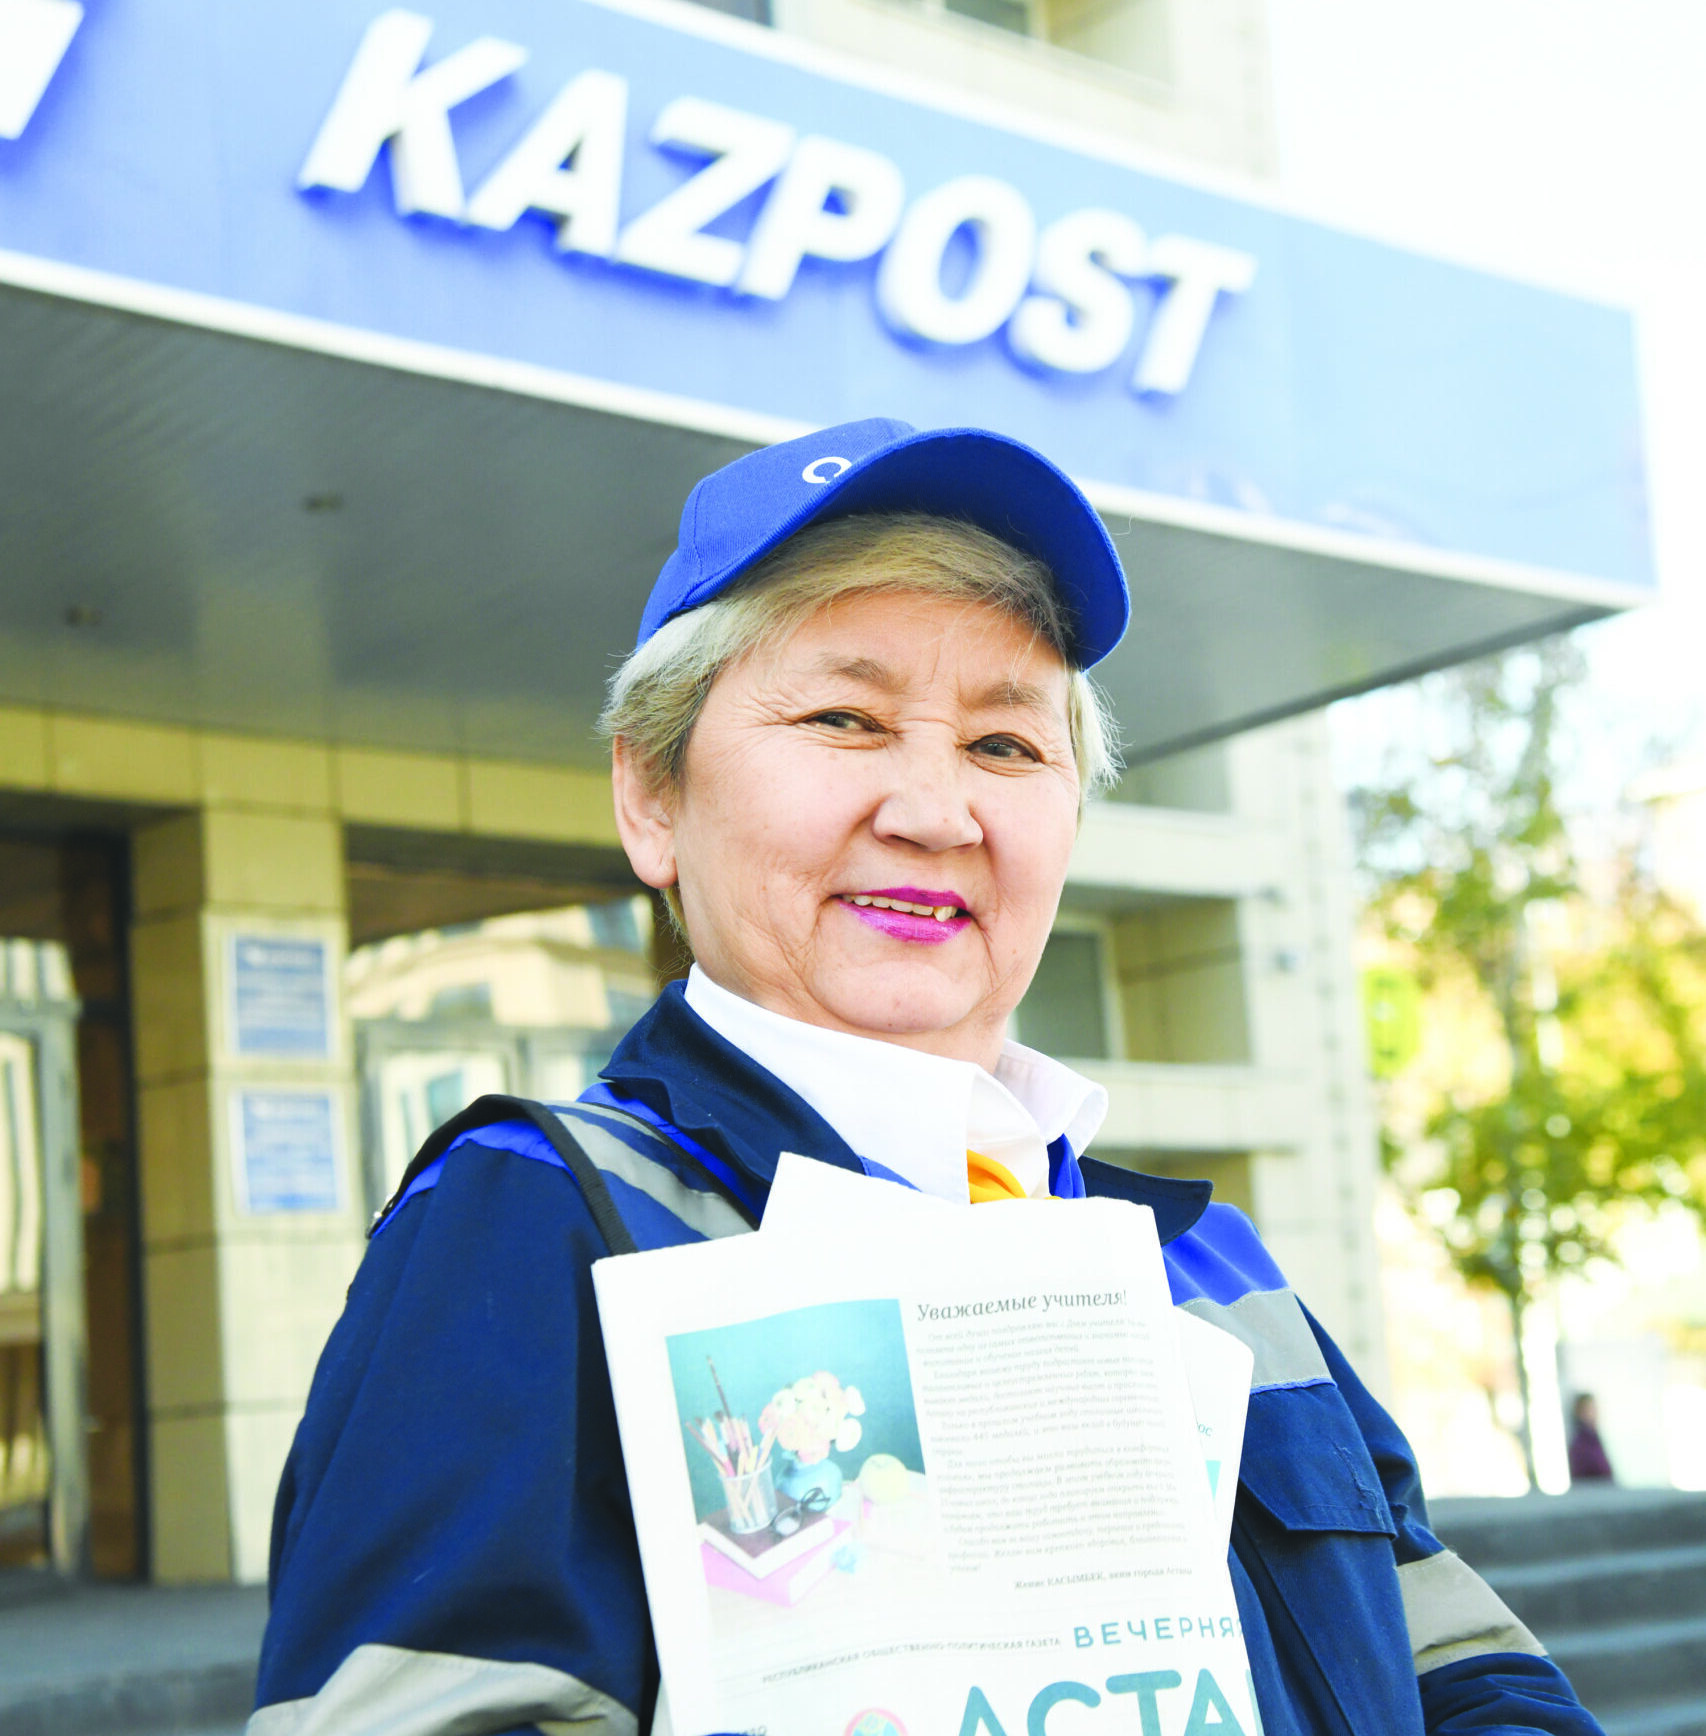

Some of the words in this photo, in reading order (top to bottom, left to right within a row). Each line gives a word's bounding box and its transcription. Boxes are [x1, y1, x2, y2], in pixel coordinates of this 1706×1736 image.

[297, 9, 1258, 395] KAZPOST
[917, 1295, 1037, 1321] Уважаемые
[1042, 1290, 1127, 1312] учителя!
[1073, 1617, 1243, 1648] ВЕЧЕРНЯ
[958, 1668, 1264, 1736] АСТА
